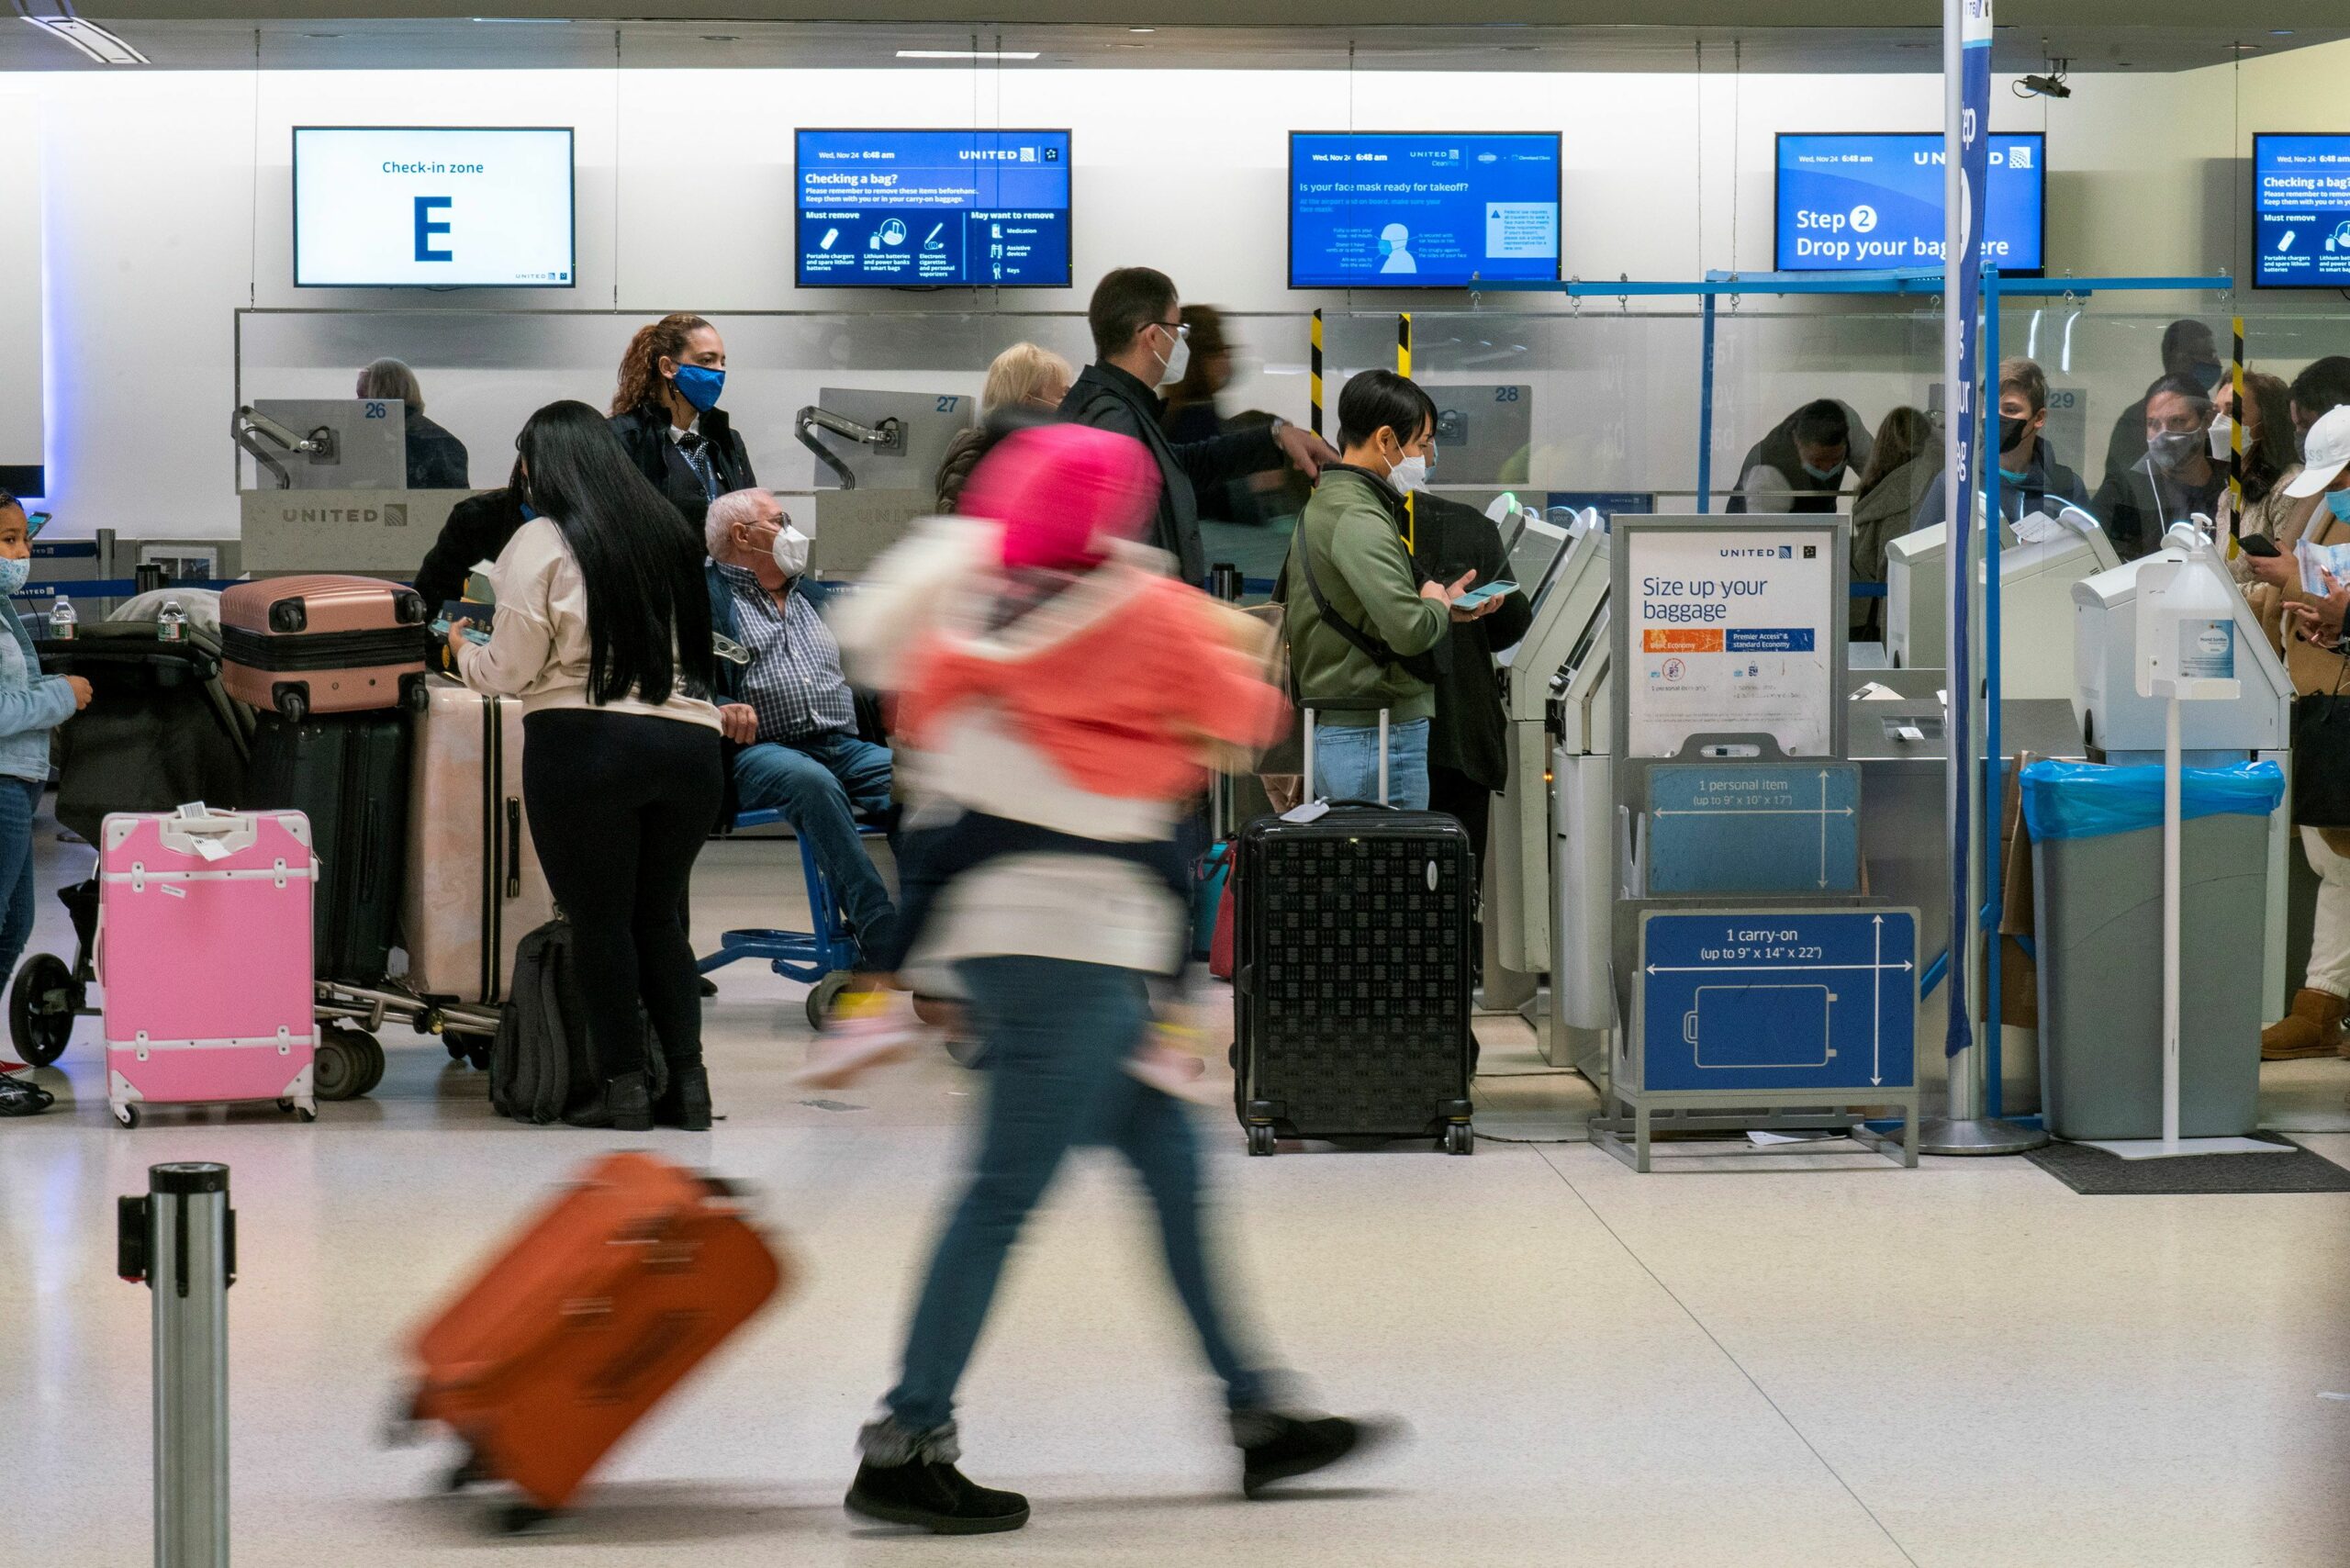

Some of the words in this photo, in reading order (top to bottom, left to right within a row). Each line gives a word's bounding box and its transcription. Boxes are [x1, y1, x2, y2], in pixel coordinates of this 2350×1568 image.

[819, 151, 835, 160] Wed,
[863, 151, 880, 159] 6:48
[958, 151, 1017, 160] UNITED
[1841, 154, 1858, 162] 6:48
[2277, 155, 2293, 163] Wed,
[2319, 154, 2336, 162] 6:48
[382, 161, 445, 174] Check-in
[450, 163, 484, 174] zone
[805, 174, 858, 186] Checking
[870, 174, 898, 186] bag?
[2264, 176, 2315, 189] Checking
[2317, 179, 2323, 187] a
[1300, 183, 1308, 192] Is
[1310, 184, 1333, 193] your
[1356, 183, 1382, 192] mask
[1383, 183, 1411, 193] ready
[1414, 183, 1428, 192] for
[1429, 182, 1469, 192] takeoff?
[805, 196, 822, 204] Keep
[934, 196, 964, 204] baggage.
[806, 211, 827, 219] Must
[970, 211, 989, 220] May
[1796, 209, 1846, 233] Step
[1858, 210, 1870, 227] 2
[414, 196, 453, 263] E
[1796, 238, 1850, 261] Drop
[1856, 241, 1908, 261] your
[1495, 386, 1518, 402] 28
[2049, 392, 2075, 409] 29
[365, 402, 386, 419] 26
[936, 396, 958, 412] 27
[283, 509, 378, 522] UNITED
[1719, 548, 1775, 557] UNITED
[1643, 577, 1684, 596] Size
[1689, 580, 1714, 599] up
[1720, 580, 1768, 599] your
[1643, 599, 1727, 622] baggage
[1733, 633, 1758, 641] Premier
[1762, 641, 1790, 650] Economy
[1699, 780, 1706, 791] 1
[1709, 779, 1760, 793] personal
[1762, 779, 1788, 791] item
[1693, 795, 1710, 806] (up
[1712, 796, 1722, 805] to
[1737, 797, 1743, 805] x
[1764, 797, 1772, 805] x
[1727, 928, 1734, 942] 1
[1738, 929, 1798, 944] carry-on
[1701, 946, 1720, 960] (up
[1722, 948, 1736, 959] to
[1753, 949, 1762, 958] x
[1787, 949, 1796, 958] x
